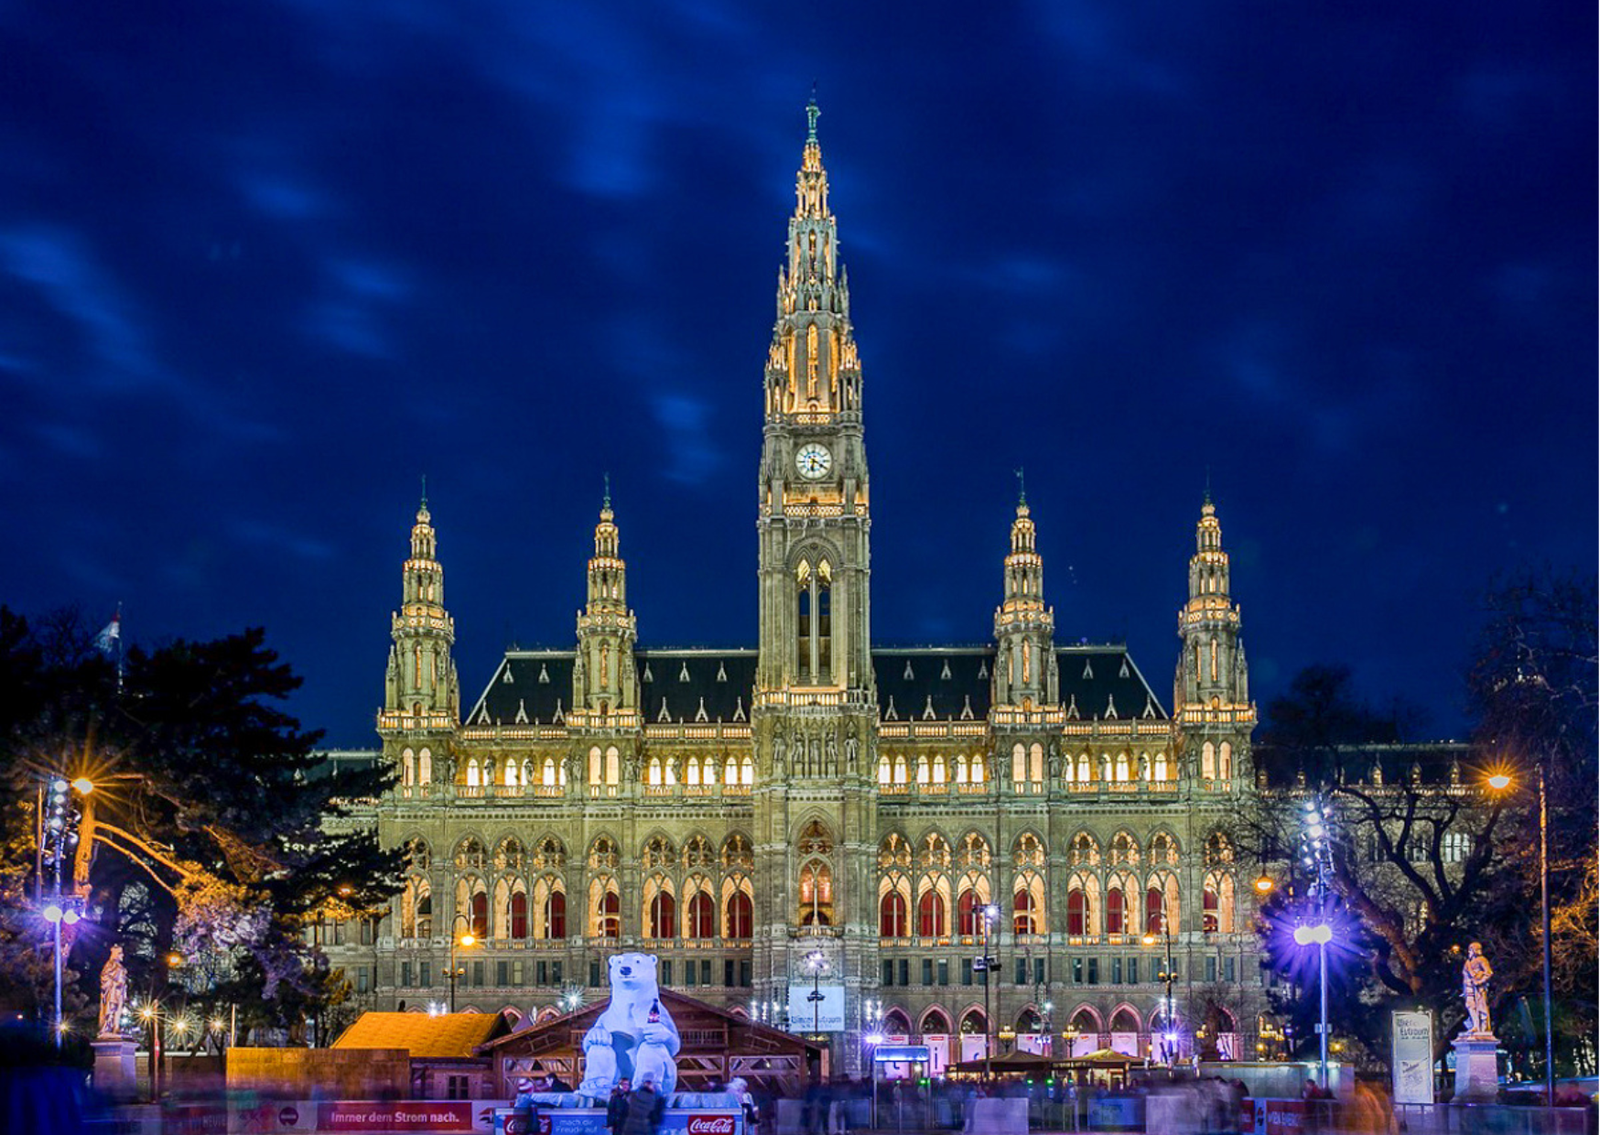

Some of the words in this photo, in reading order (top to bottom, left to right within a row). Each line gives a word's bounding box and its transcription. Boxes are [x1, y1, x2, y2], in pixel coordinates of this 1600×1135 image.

[331, 1112, 365, 1122] Immer
[368, 1112, 392, 1122] dem
[394, 1112, 427, 1122] Strom
[430, 1112, 460, 1122] nach.
